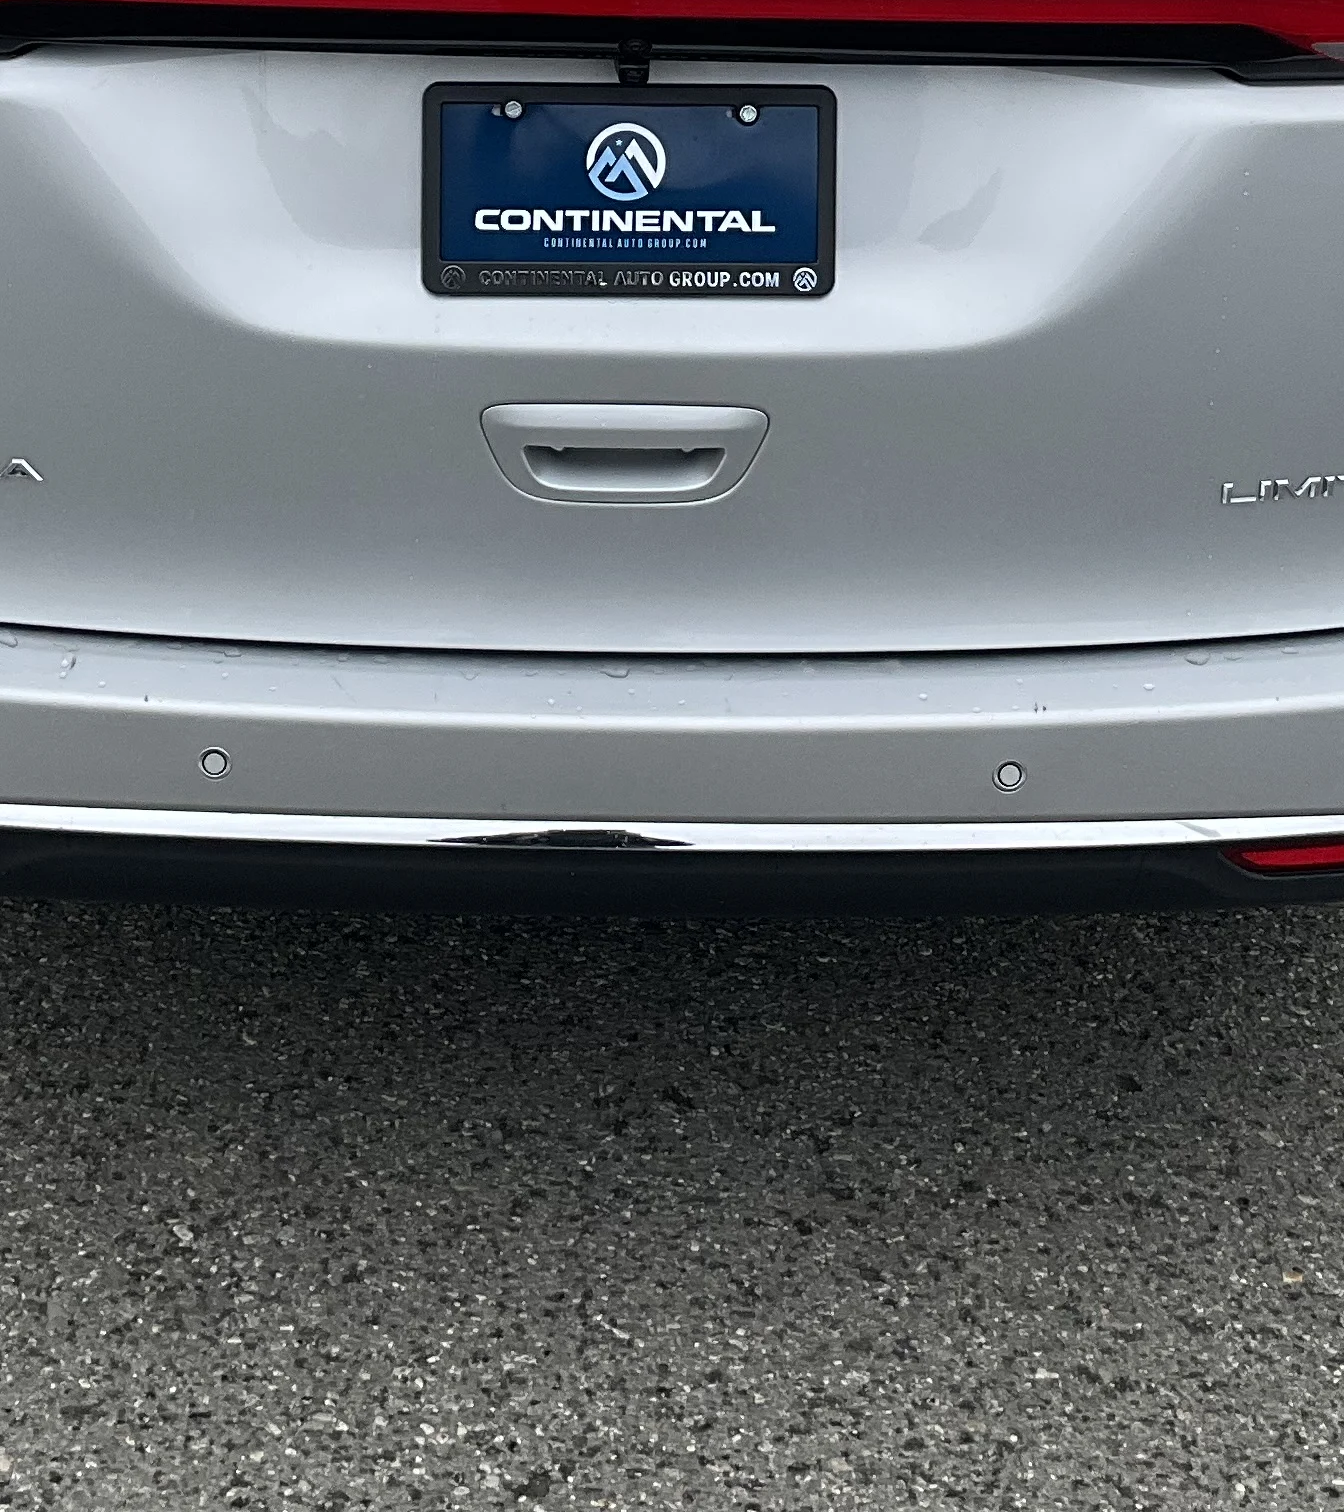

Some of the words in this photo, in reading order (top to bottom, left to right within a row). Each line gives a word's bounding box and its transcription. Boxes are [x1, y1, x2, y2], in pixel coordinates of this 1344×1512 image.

[474, 208, 777, 233] CONTINENTAL
[543, 237, 614, 249] CONTINENTAL
[616, 237, 644, 249] AUTO
[478, 270, 609, 287] CONTINENTAL
[613, 270, 665, 287] AUTO
